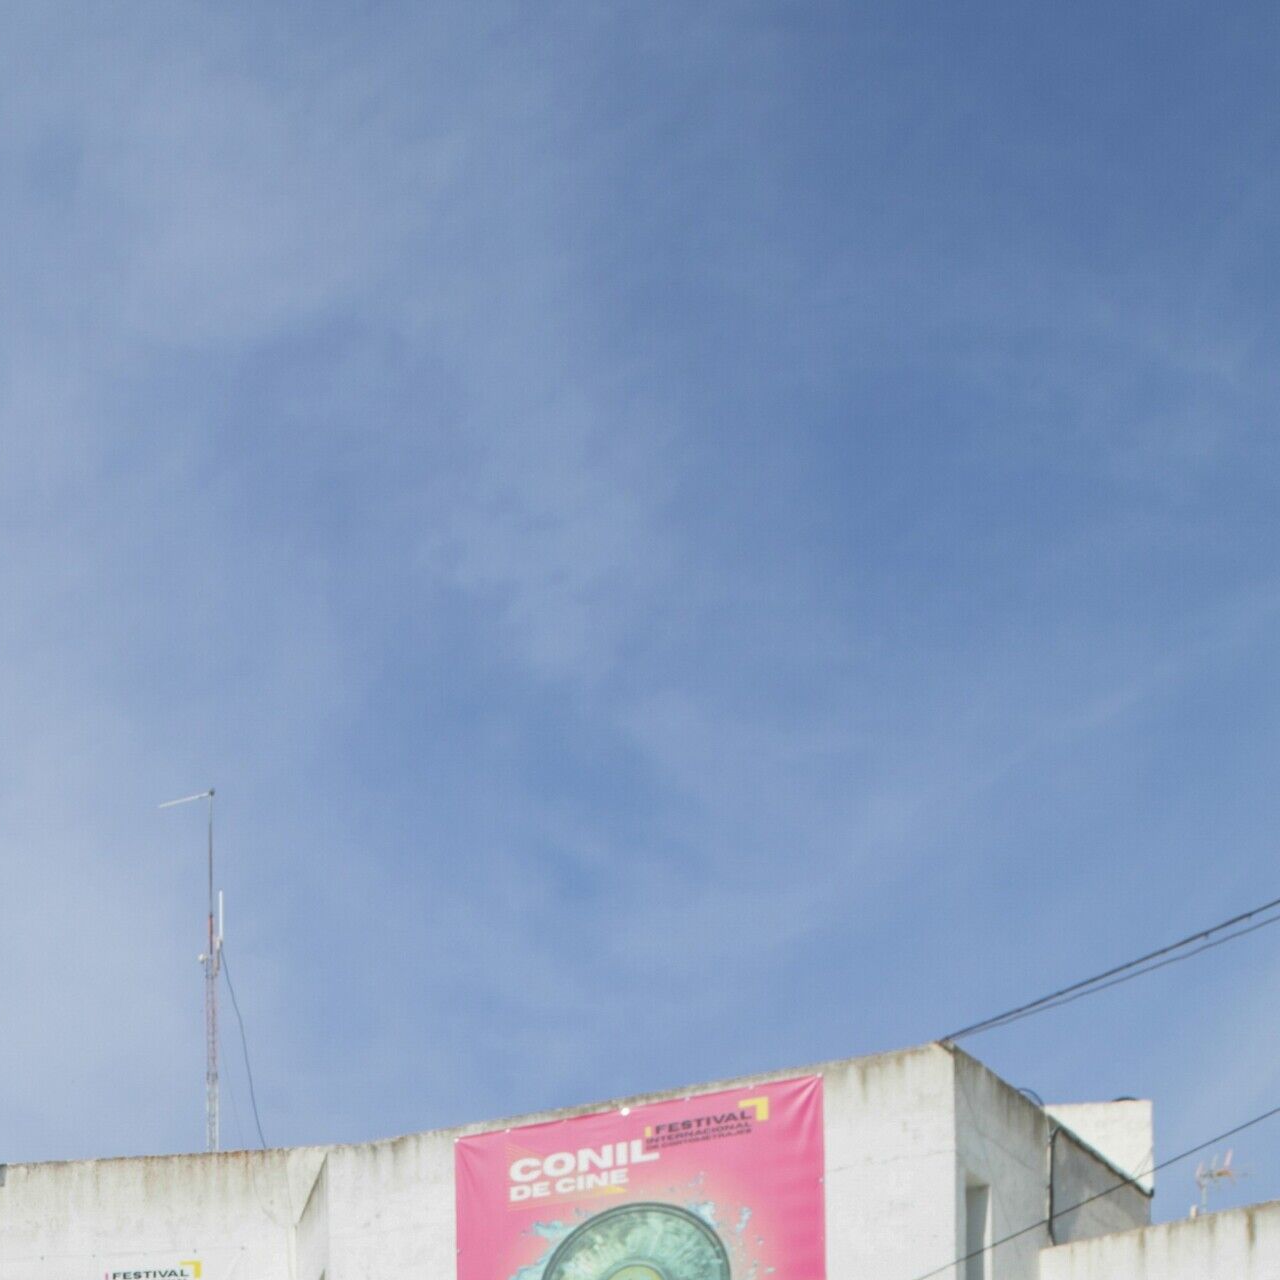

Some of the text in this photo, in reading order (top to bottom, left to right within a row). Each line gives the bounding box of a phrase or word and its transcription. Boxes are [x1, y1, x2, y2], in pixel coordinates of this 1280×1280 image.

[655, 1110, 752, 1135] FESTIVAL
[509, 1139, 660, 1182] CONIL
[509, 1167, 629, 1202] DE CINE
[113, 1269, 189, 1280] FESTIVAL
